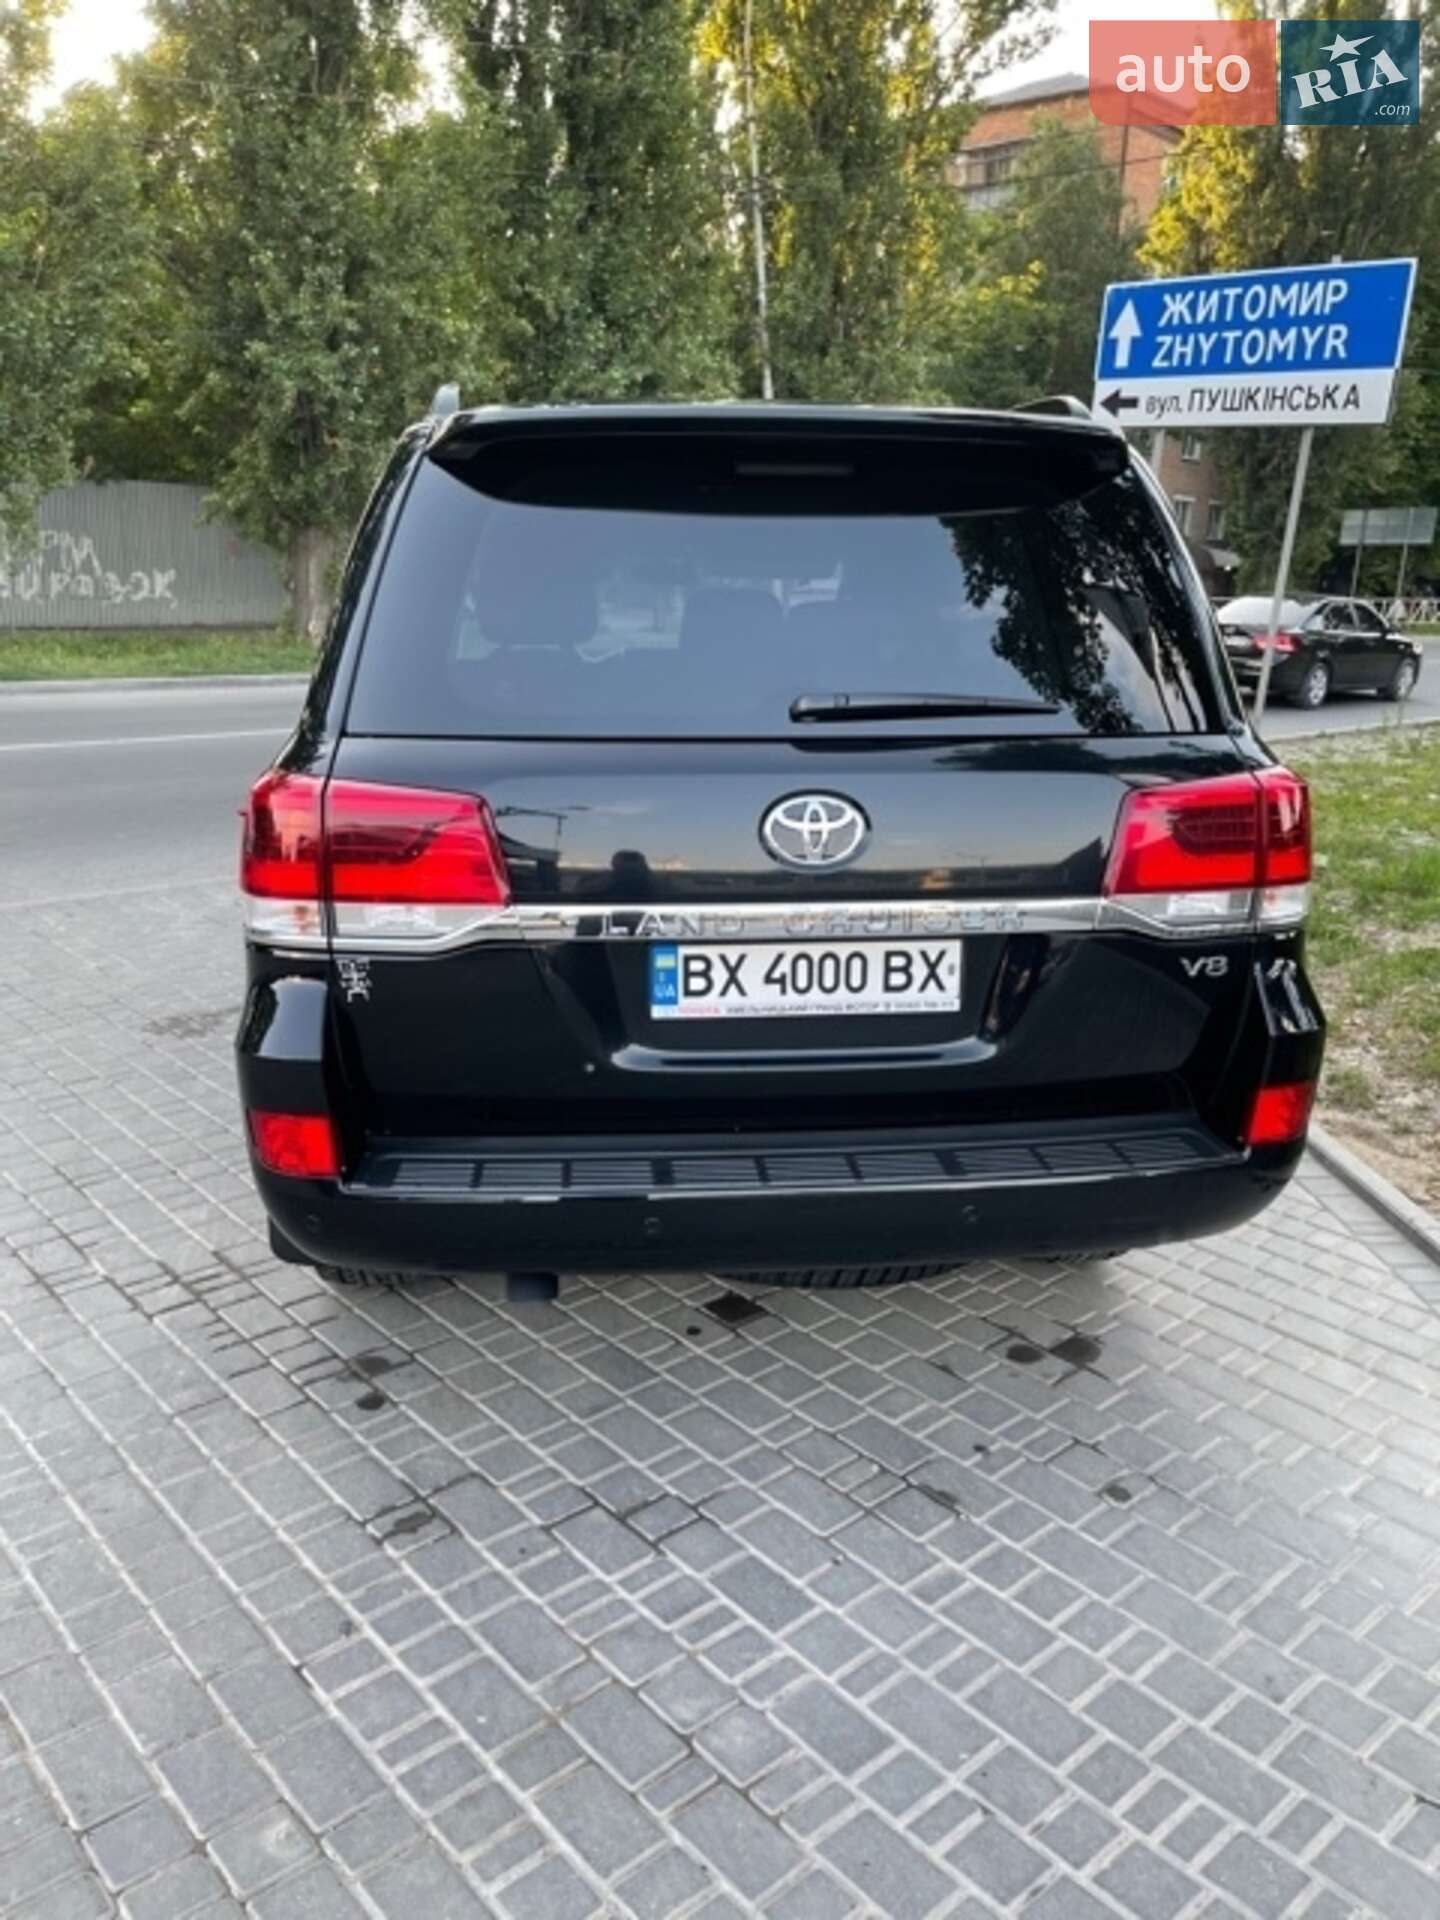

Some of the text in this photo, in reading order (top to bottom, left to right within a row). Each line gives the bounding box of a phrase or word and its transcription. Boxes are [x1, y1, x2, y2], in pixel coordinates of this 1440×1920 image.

[1157, 279, 1349, 328] ЖИТОМИР
[1151, 324, 1349, 368] ZHYTOMYR
[1145, 384, 1361, 419] вул. ПУШКІНСЬКА
[601, 906, 1028, 937] LAND CRUISER
[763, 951, 869, 997] 4000
[1179, 955, 1229, 978] V8
[653, 982, 676, 998] UA
